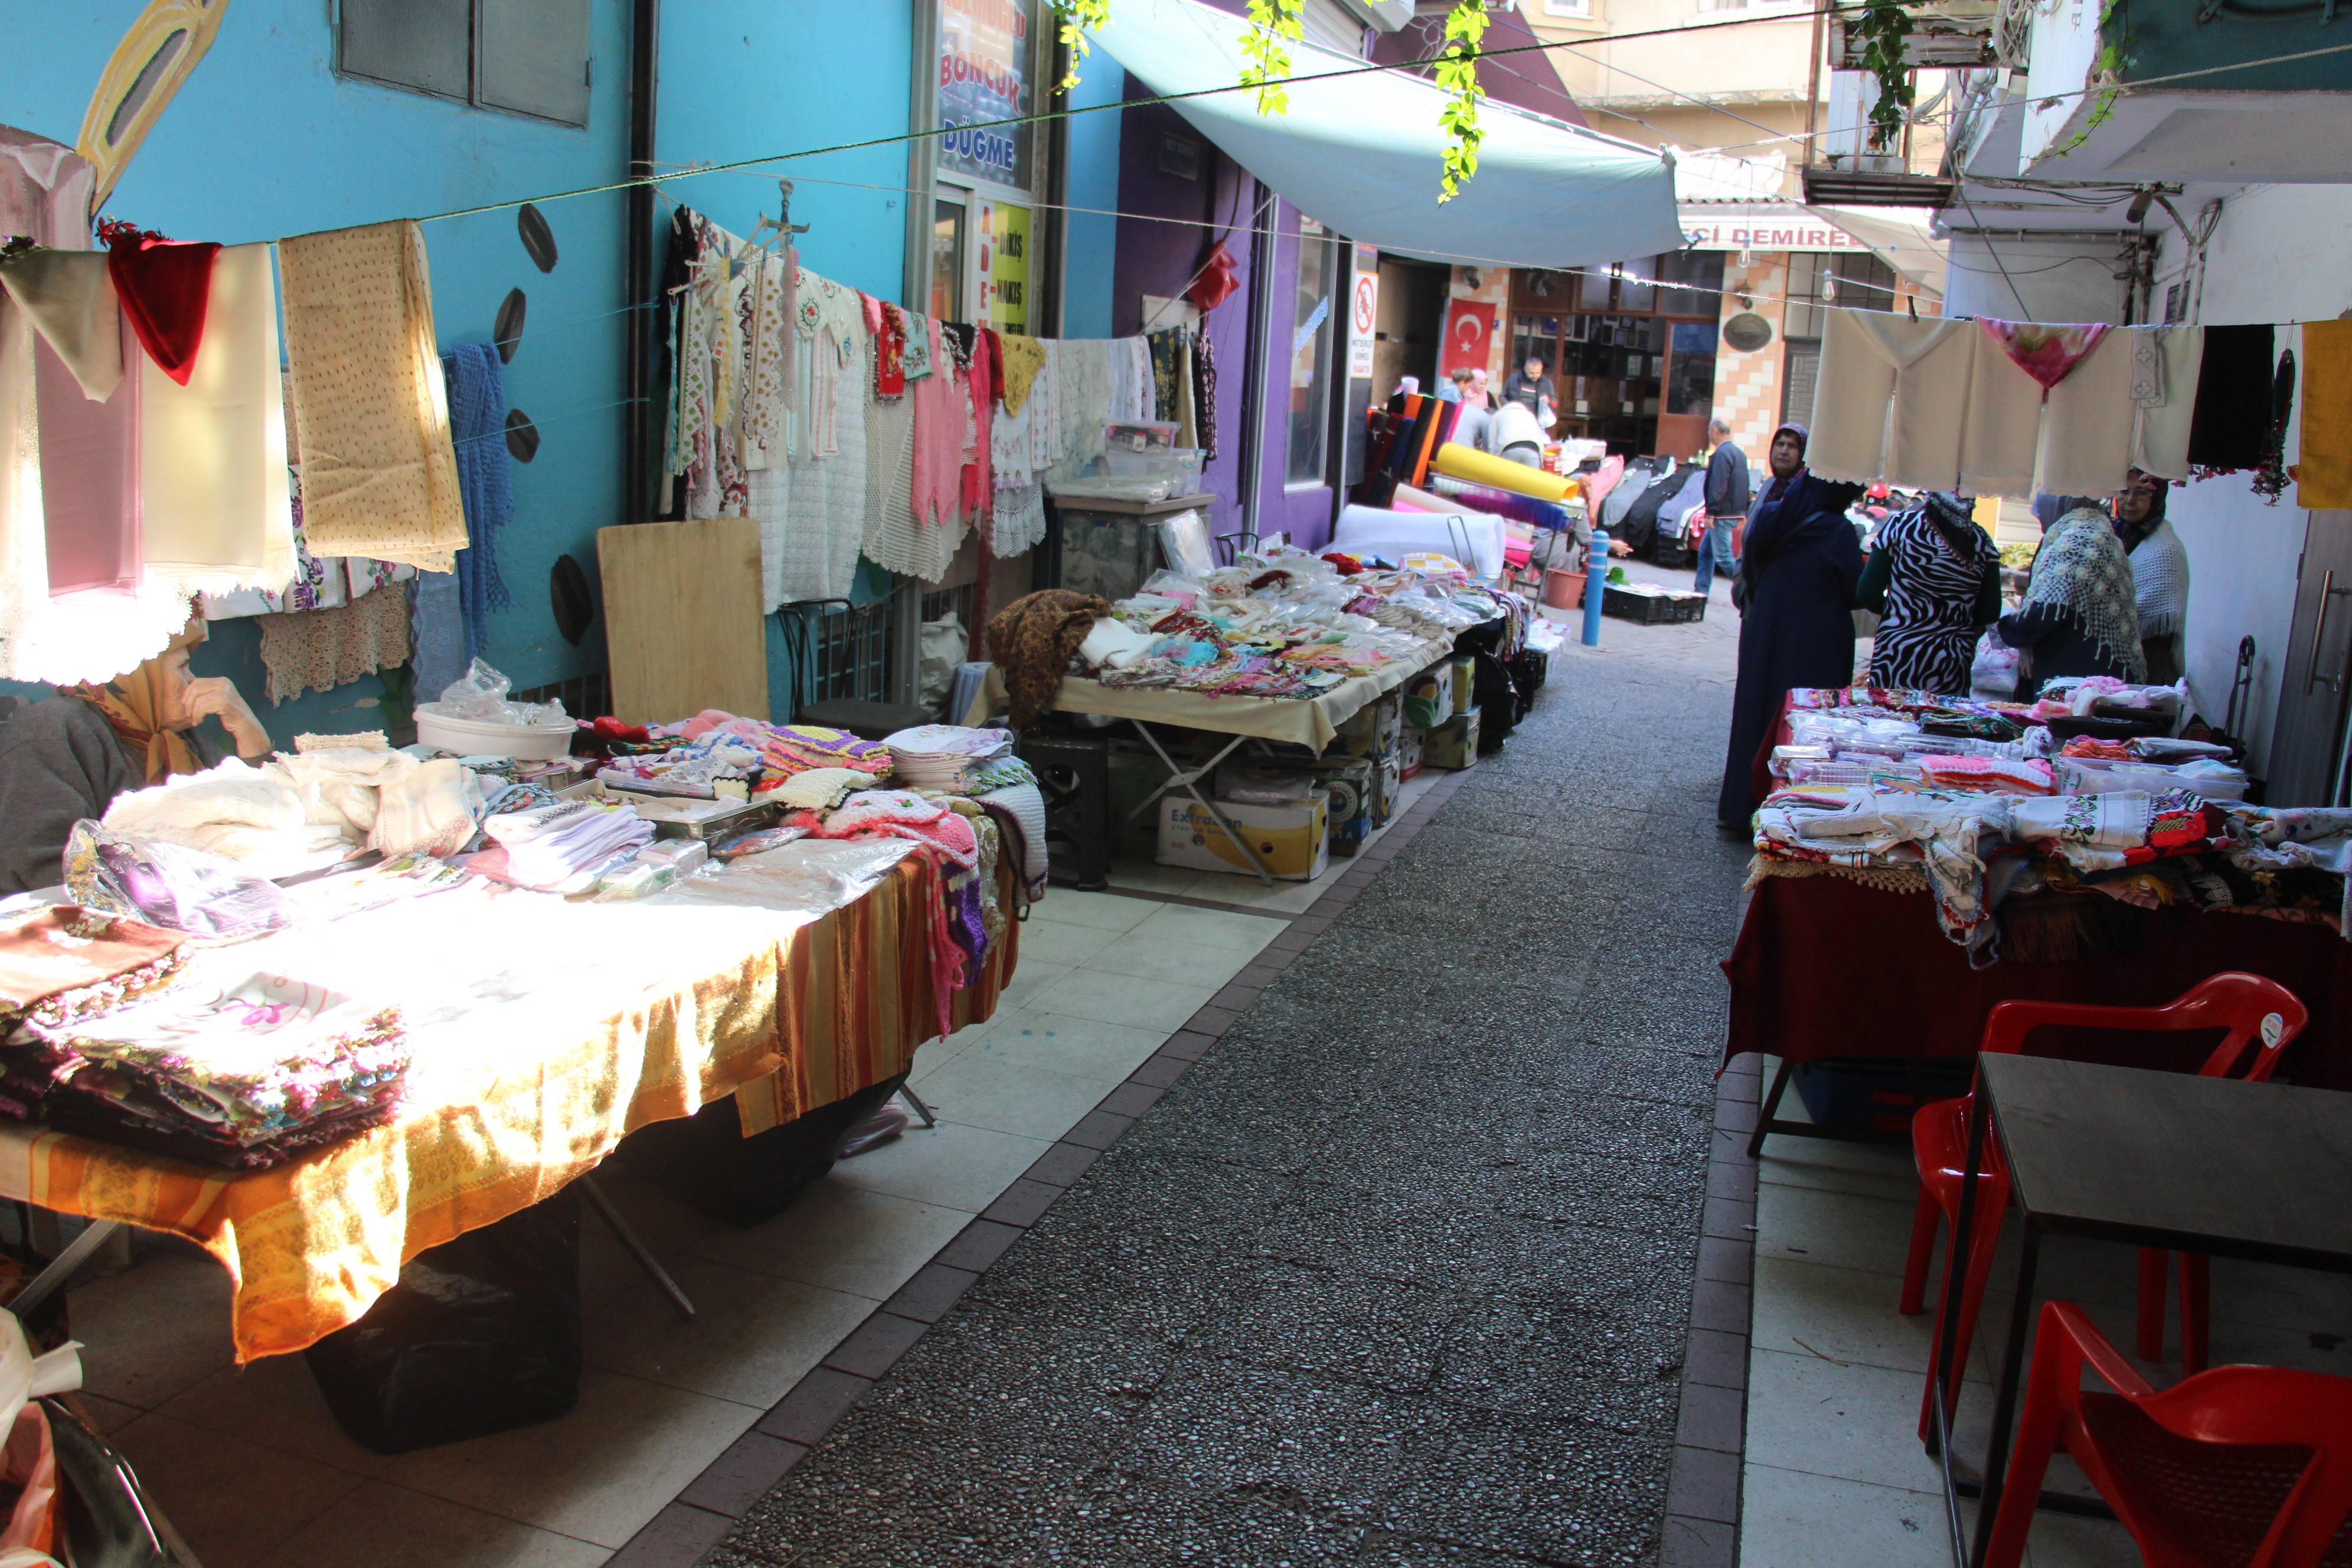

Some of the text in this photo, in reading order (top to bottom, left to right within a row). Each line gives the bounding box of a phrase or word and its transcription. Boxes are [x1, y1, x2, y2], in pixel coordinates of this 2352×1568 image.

[940, 51, 1020, 117] BONCUK
[1352, 338, 1374, 348] MOTOSİKLET
[1355, 351, 1370, 361] GİRMESİ
[1353, 364, 1370, 374] YASAKTIR
